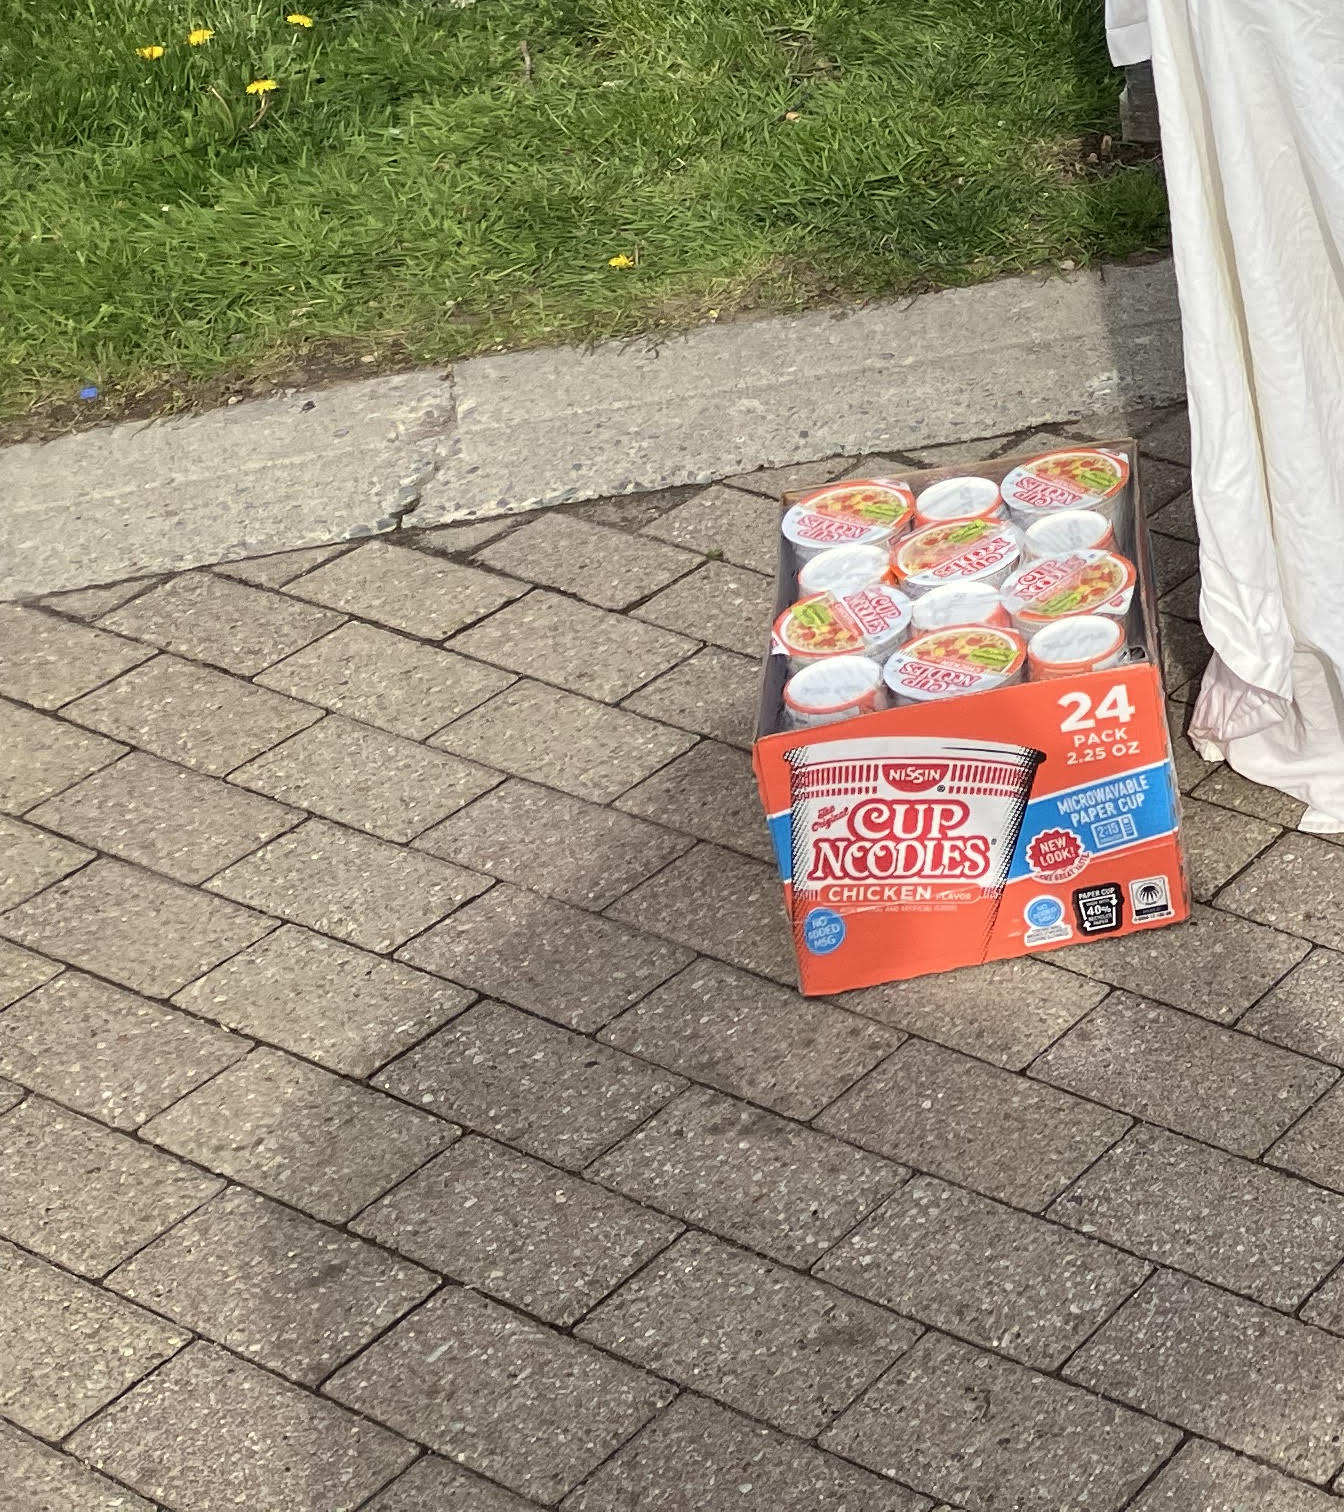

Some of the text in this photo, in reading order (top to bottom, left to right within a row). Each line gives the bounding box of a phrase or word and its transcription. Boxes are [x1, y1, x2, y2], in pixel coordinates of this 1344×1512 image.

[900, 660, 982, 688] NOODLES
[902, 675, 951, 693] CUP
[1056, 684, 1136, 733] 24
[1073, 727, 1128, 748] PACK
[1066, 741, 1141, 766] 2.25 OZ
[888, 765, 942, 784] NISSIN
[1056, 773, 1150, 816] MICROWAVABLE
[1070, 792, 1146, 828] PAPER CUP
[850, 800, 967, 840] CUP
[1097, 821, 1121, 838] 2:15
[1039, 836, 1067, 854] NEW
[812, 838, 988, 879] NOODLES
[1039, 847, 1076, 867] LOOK!
[828, 885, 973, 903] CHICKEN FLAVOR
[1078, 887, 1116, 901] PAPER CUP
[1086, 903, 1112, 917] 40%
[807, 923, 841, 939] ADDED
[812, 916, 828, 929] NO
[814, 935, 836, 949] MSG
